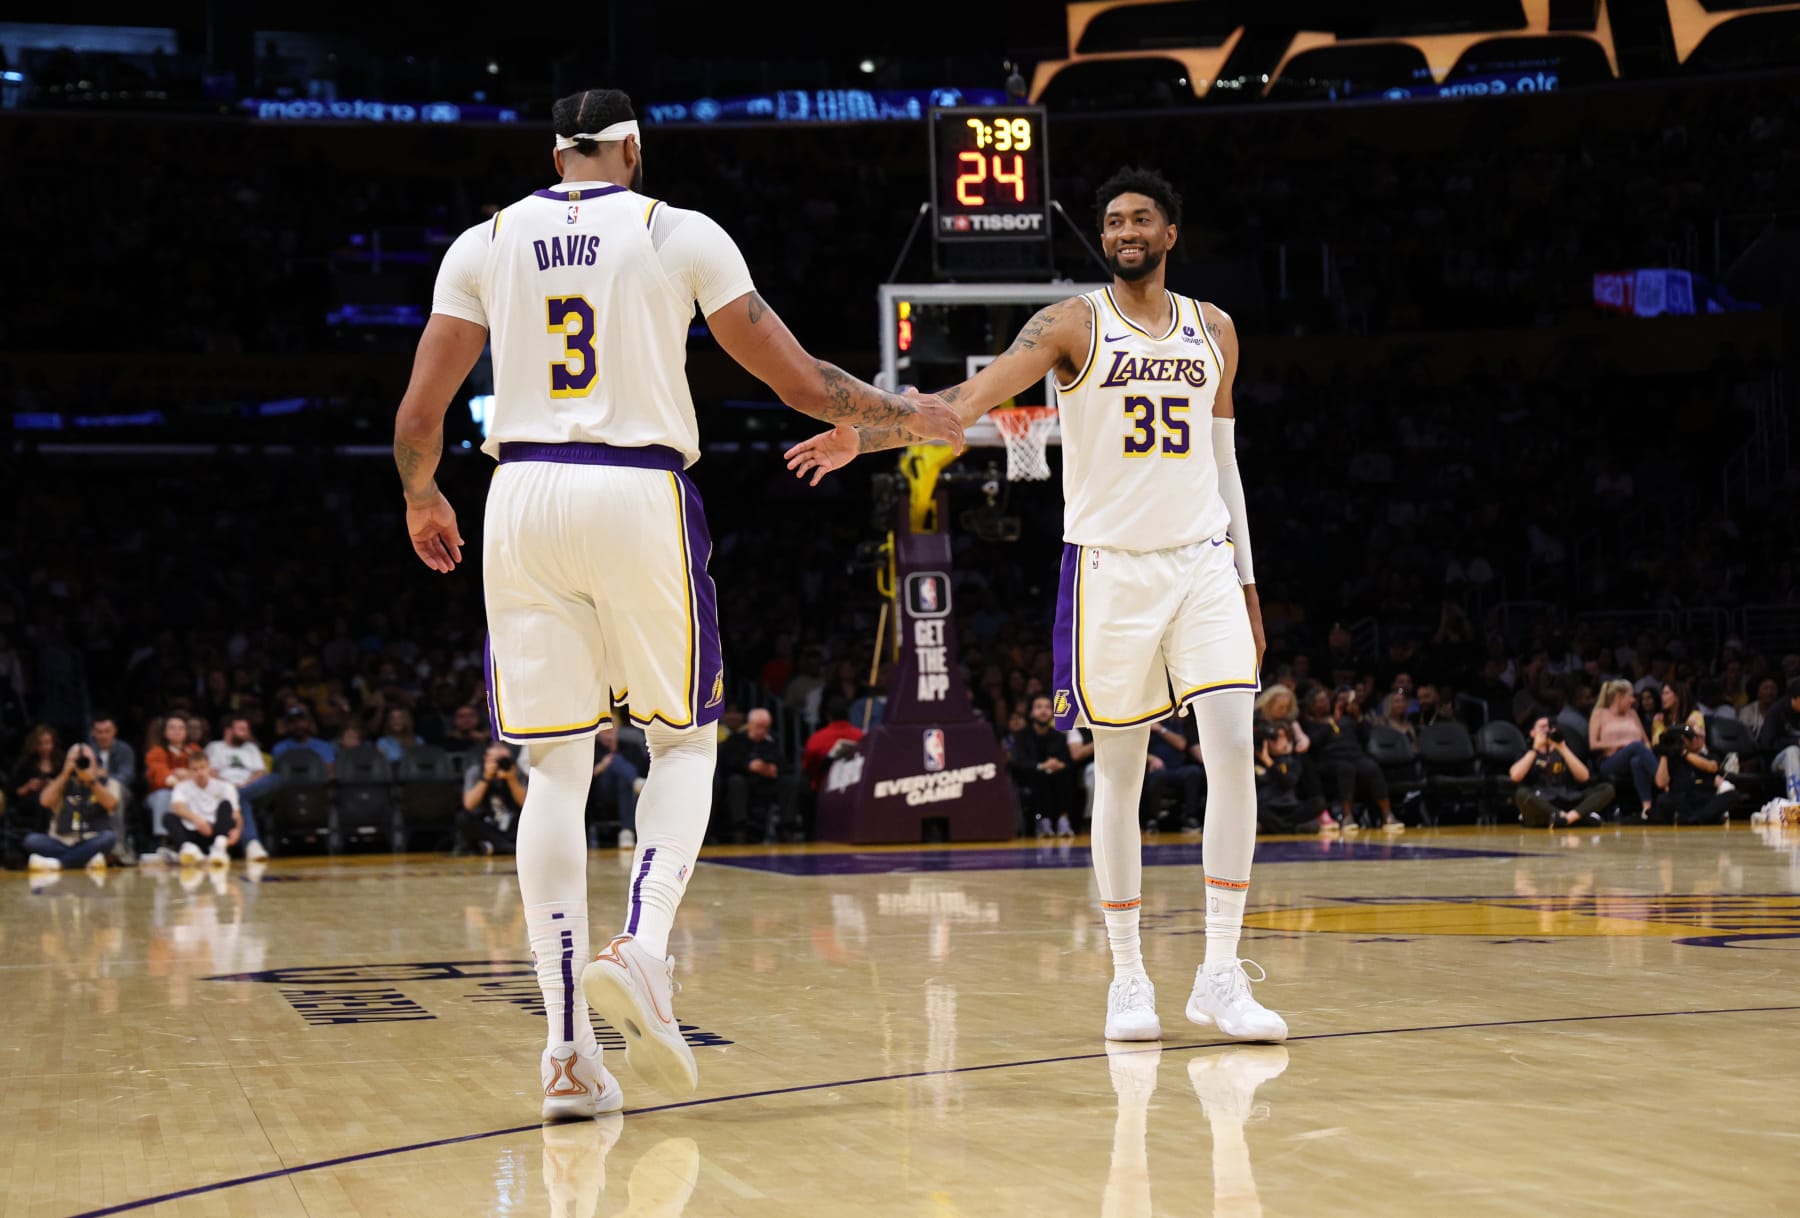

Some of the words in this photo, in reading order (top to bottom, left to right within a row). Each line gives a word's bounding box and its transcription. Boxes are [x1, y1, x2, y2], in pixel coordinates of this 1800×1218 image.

[966, 118, 1031, 151] 7:39
[956, 151, 1024, 206] 24
[970, 213, 1043, 230] TISSOT
[533, 234, 600, 271] DAVIS
[545, 294, 599, 399] 3
[1099, 350, 1208, 388] LAKERS
[1123, 395, 1191, 459] 35
[914, 619, 946, 646] GET
[915, 647, 949, 673] THE
[917, 674, 950, 701] APP
[874, 763, 997, 798] EVERYONE'S
[906, 783, 964, 806] GAME
